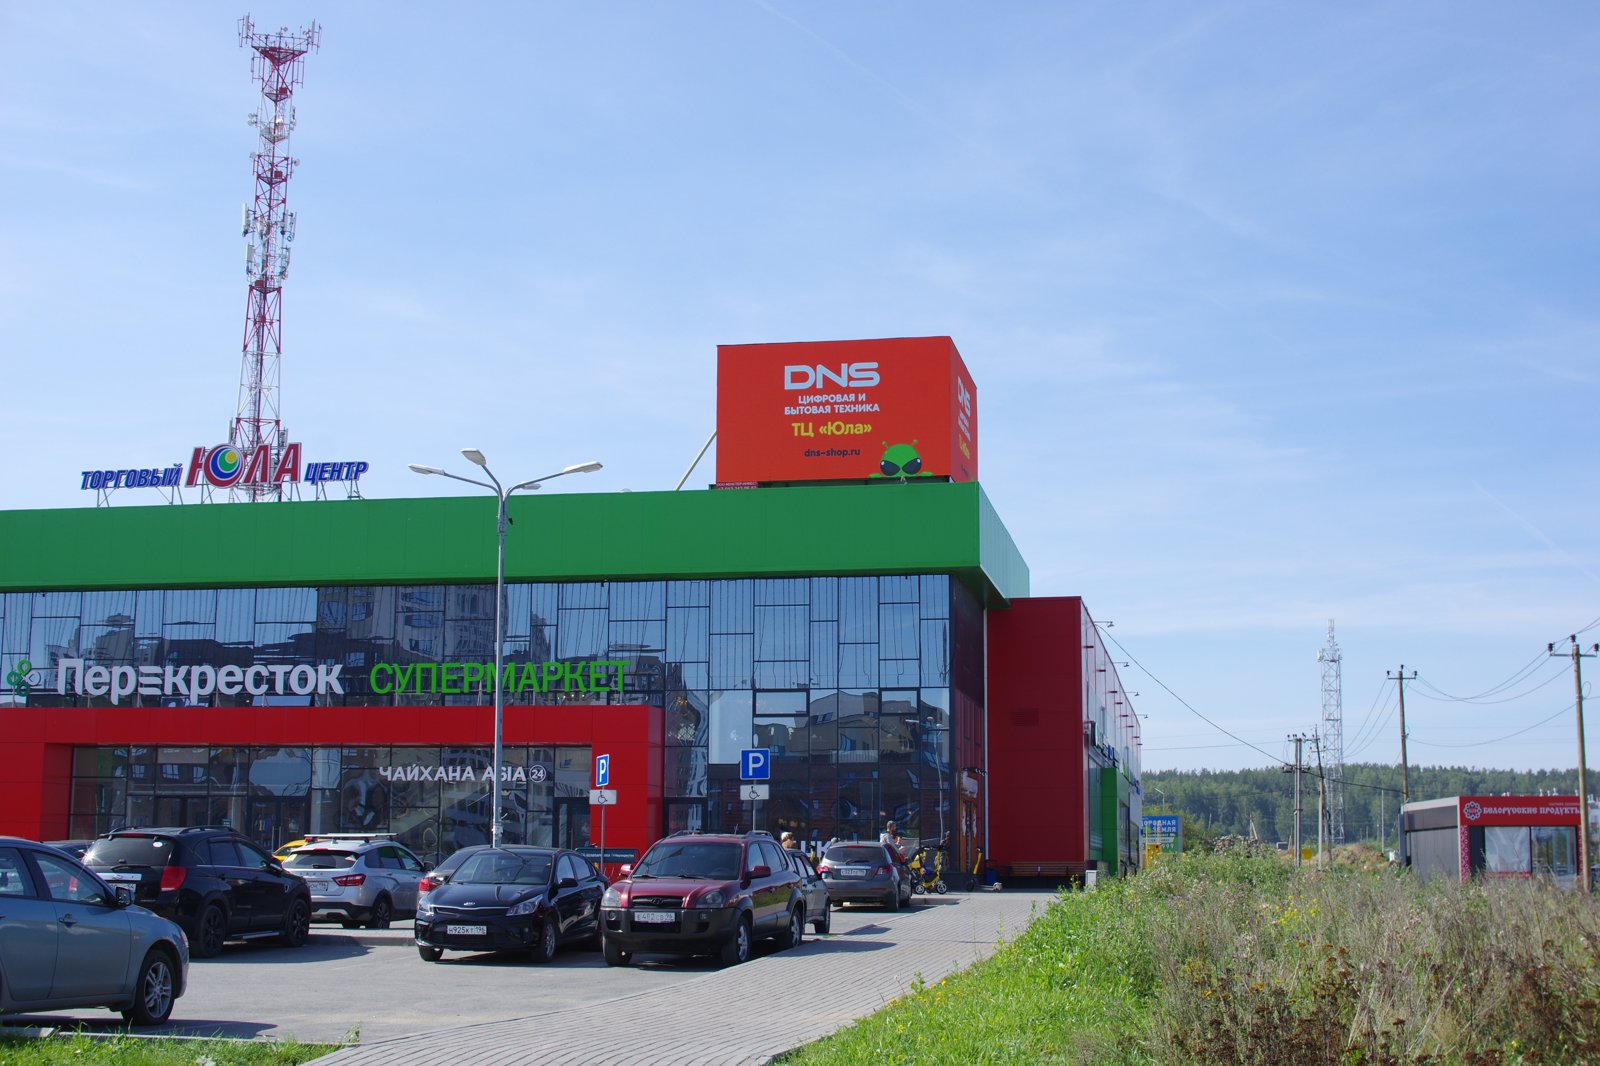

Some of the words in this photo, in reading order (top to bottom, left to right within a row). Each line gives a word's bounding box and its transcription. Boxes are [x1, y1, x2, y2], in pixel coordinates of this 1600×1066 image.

[784, 361, 881, 390] DNS
[798, 393, 855, 404] ЦИФРОВАЯ
[858, 393, 866, 402] И
[784, 405, 831, 415] БЫТОВАЯ
[834, 403, 880, 414] ТЕХНИКА
[792, 422, 814, 437] ТЦ
[819, 421, 872, 435] «Юла»
[804, 448, 860, 458] dns-shop.ru
[81, 463, 183, 490] ТОРГОВЫЙ
[184, 442, 302, 489] ЮЛА
[304, 461, 369, 483] ЦЕНТР
[370, 660, 631, 694] СУПЕРМАРКЕТ
[379, 764, 475, 782] ЧАЙХАНА
[748, 753, 764, 776] P
